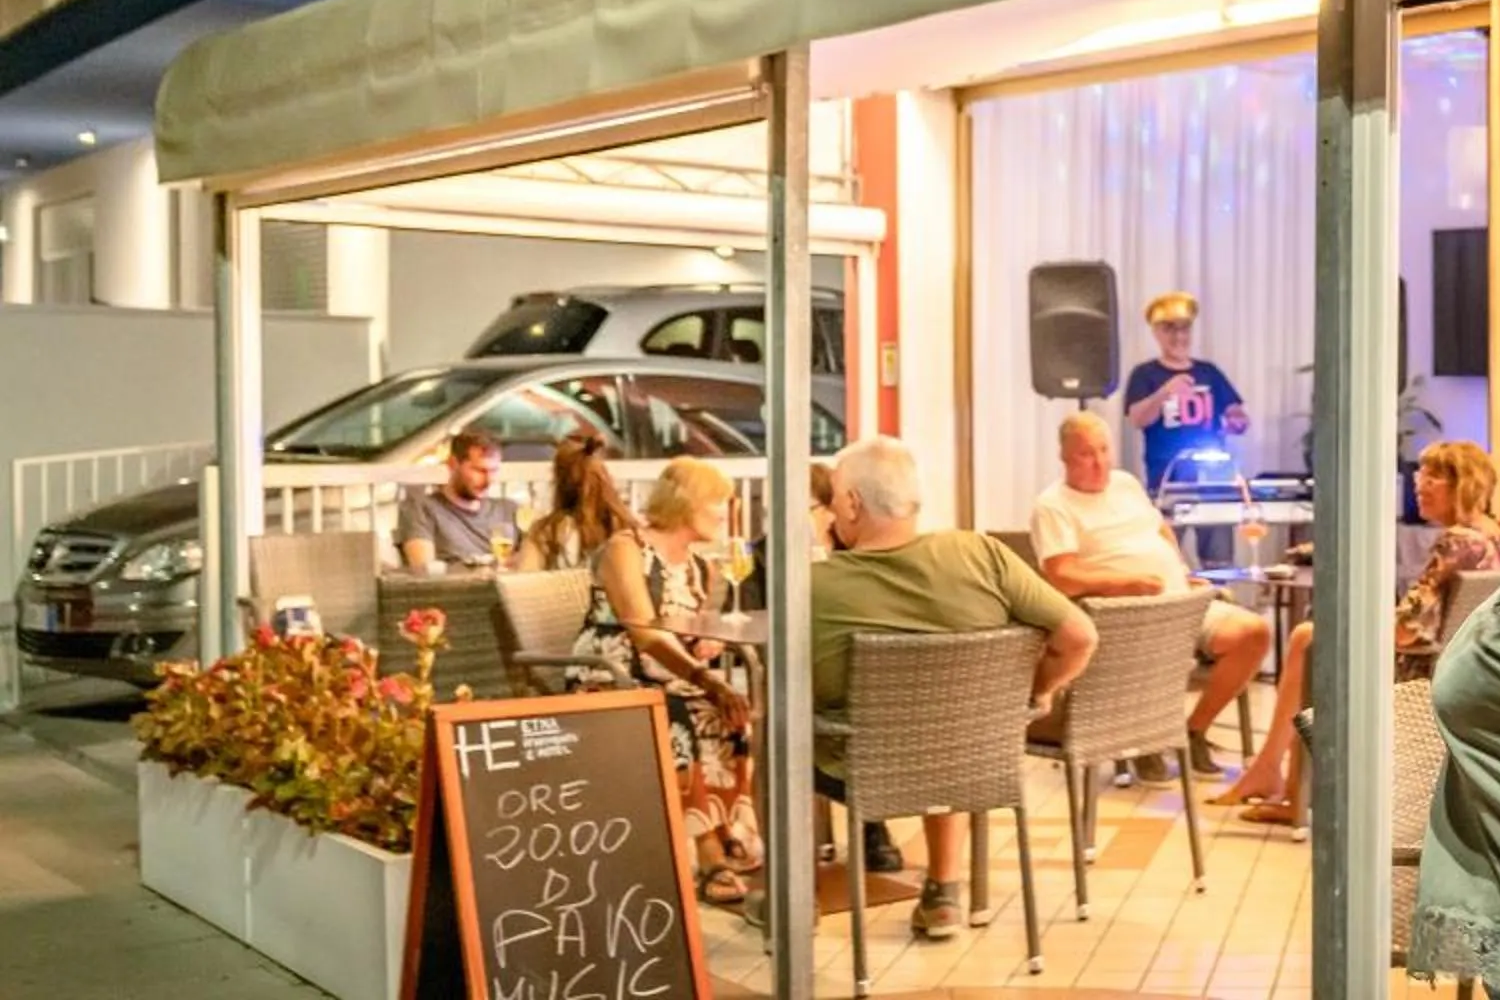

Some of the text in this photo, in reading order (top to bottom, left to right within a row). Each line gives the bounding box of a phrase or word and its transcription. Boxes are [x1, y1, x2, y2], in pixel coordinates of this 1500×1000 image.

[453, 719, 520, 779] HE
[498, 779, 590, 819] ORE
[484, 817, 632, 870] 20.00
[535, 859, 599, 910] DJ
